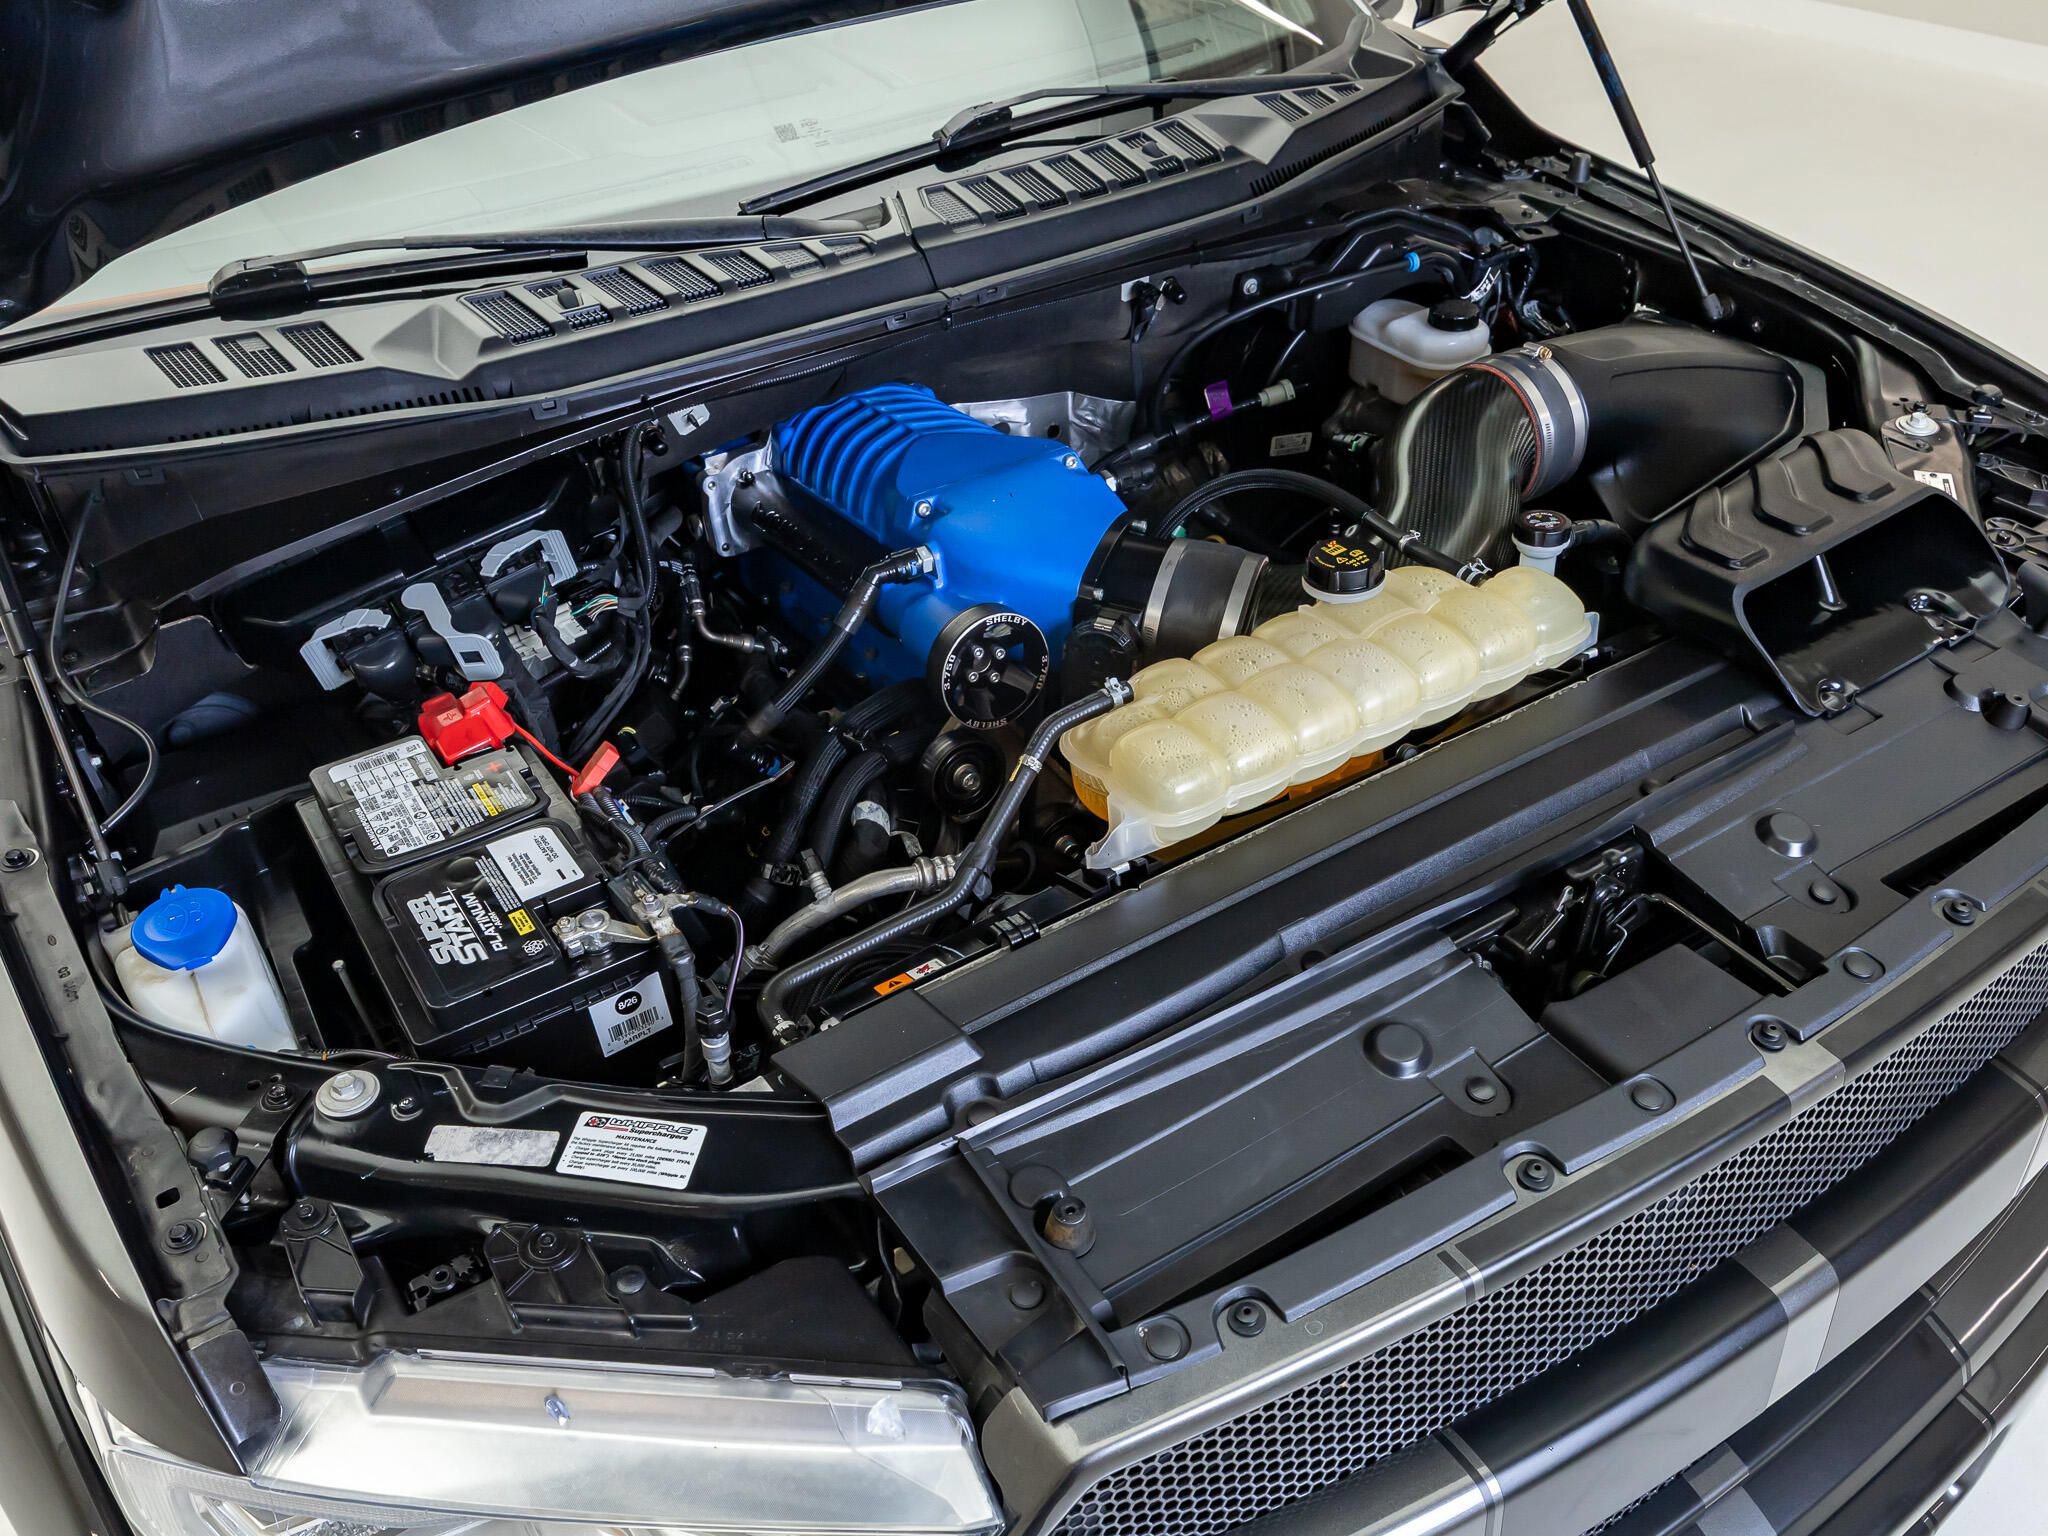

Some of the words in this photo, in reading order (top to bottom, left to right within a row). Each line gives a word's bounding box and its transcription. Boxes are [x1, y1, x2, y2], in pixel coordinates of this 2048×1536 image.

[986, 615, 1028, 626] SHELBY
[943, 654, 956, 691] 3.750
[966, 717, 1008, 728] SHELBY
[545, 845, 555, 853] NOT
[425, 891, 489, 965] START
[461, 892, 508, 952] PLATINUM
[407, 896, 452, 965] SUPER
[618, 996, 638, 1011] 8/26
[623, 1028, 652, 1045] 94RPLT
[609, 1118, 692, 1135] WHIPPLE
[629, 1128, 689, 1140] Superchargers
[615, 1134, 657, 1143] MAINTENANCE
